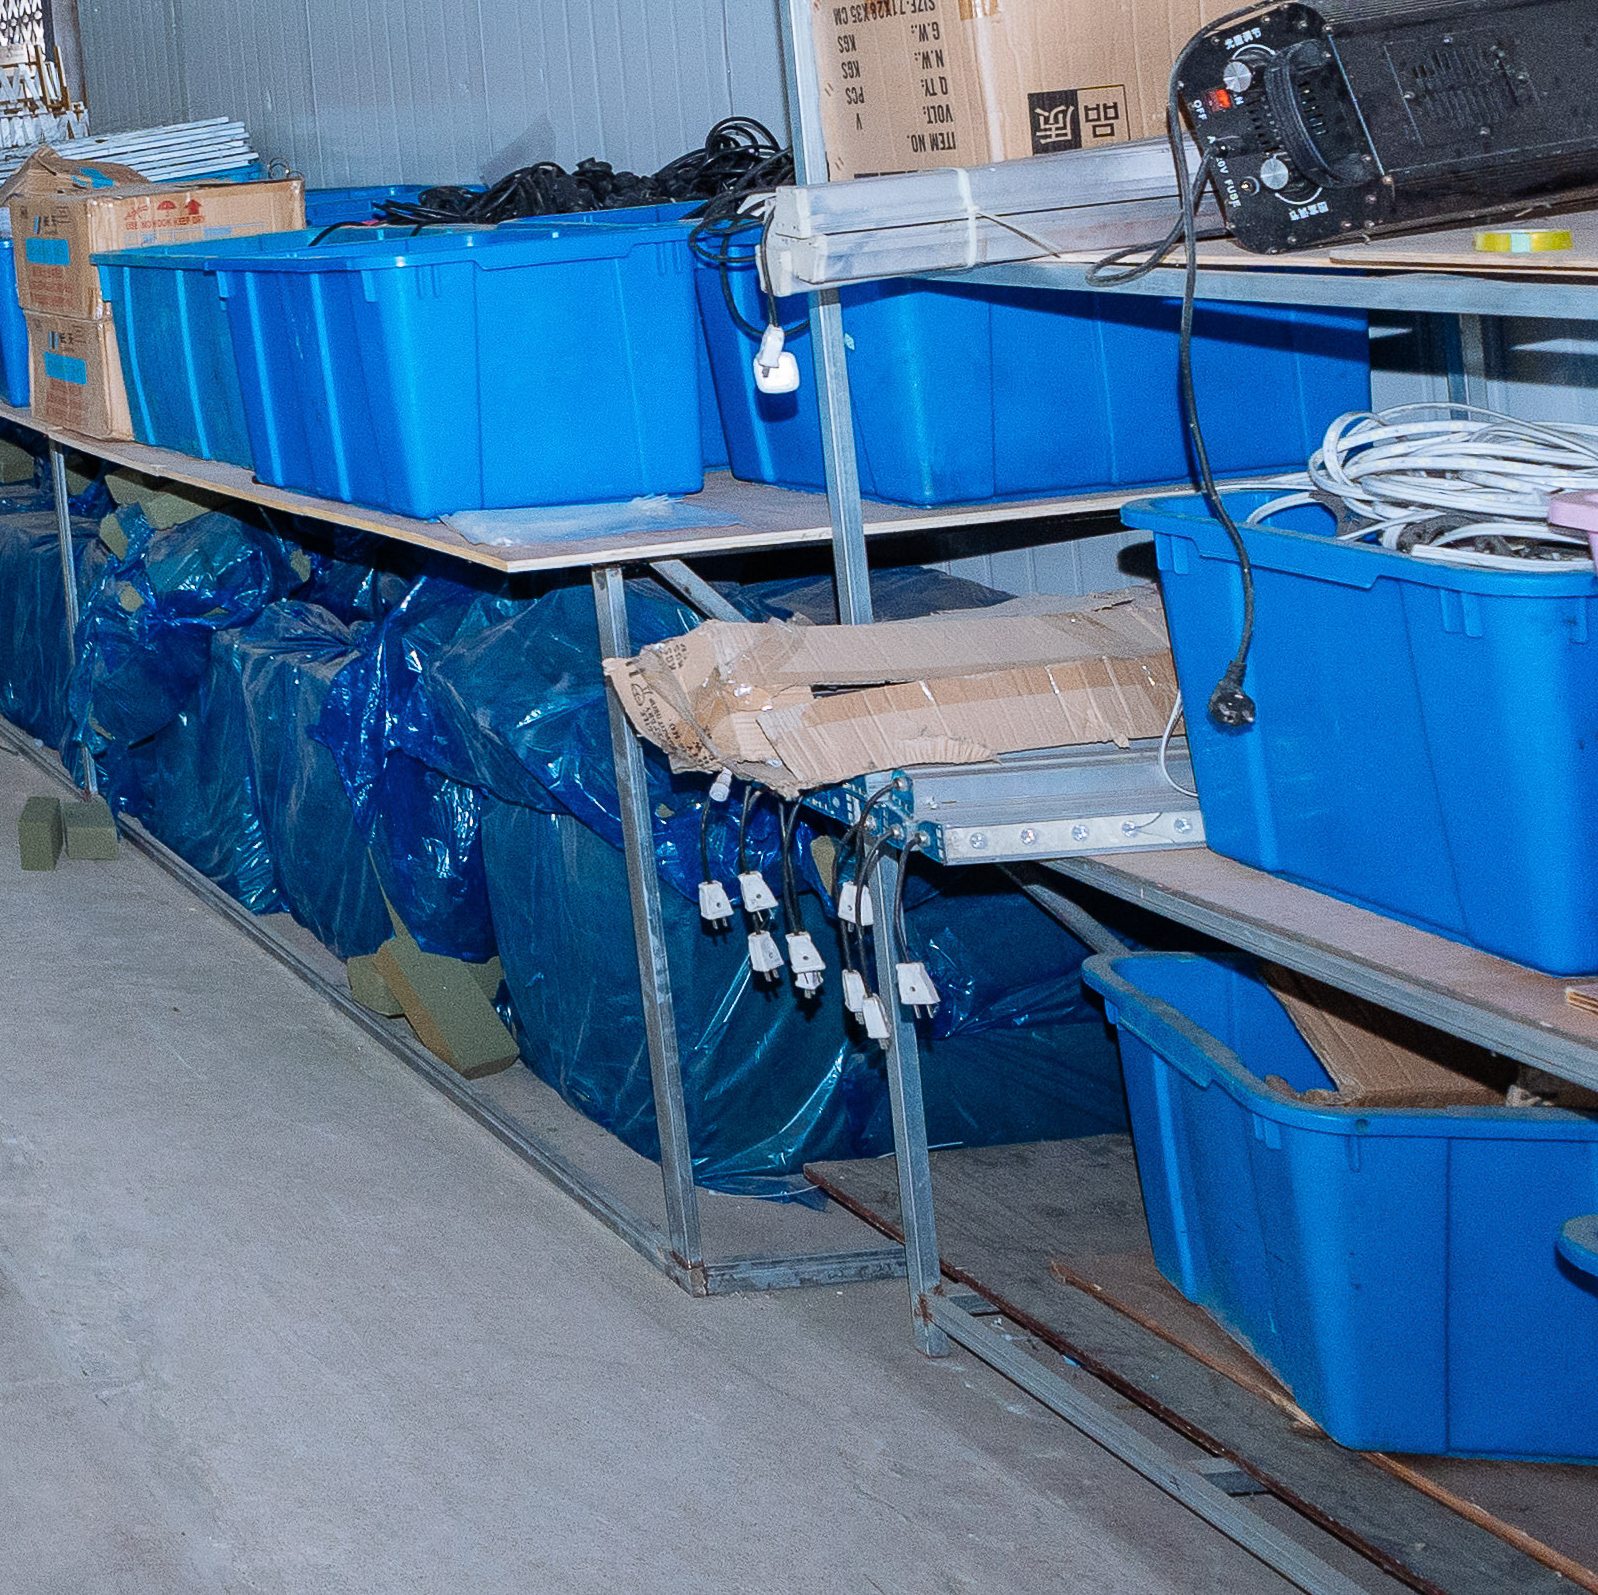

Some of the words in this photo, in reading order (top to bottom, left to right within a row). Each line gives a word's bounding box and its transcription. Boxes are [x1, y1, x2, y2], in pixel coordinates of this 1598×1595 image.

[833, 8, 849, 25] CM
[838, 35, 857, 53] KGS
[842, 60, 860, 79] KGS
[846, 87, 864, 105] PCS
[1193, 100, 1207, 120] OFF
[856, 114, 863, 130] V
[1034, 102, 1120, 145] 品质
[907, 135, 926, 152] NO.
[931, 131, 956, 151] ITEM
[1225, 179, 1241, 208] FUSE
